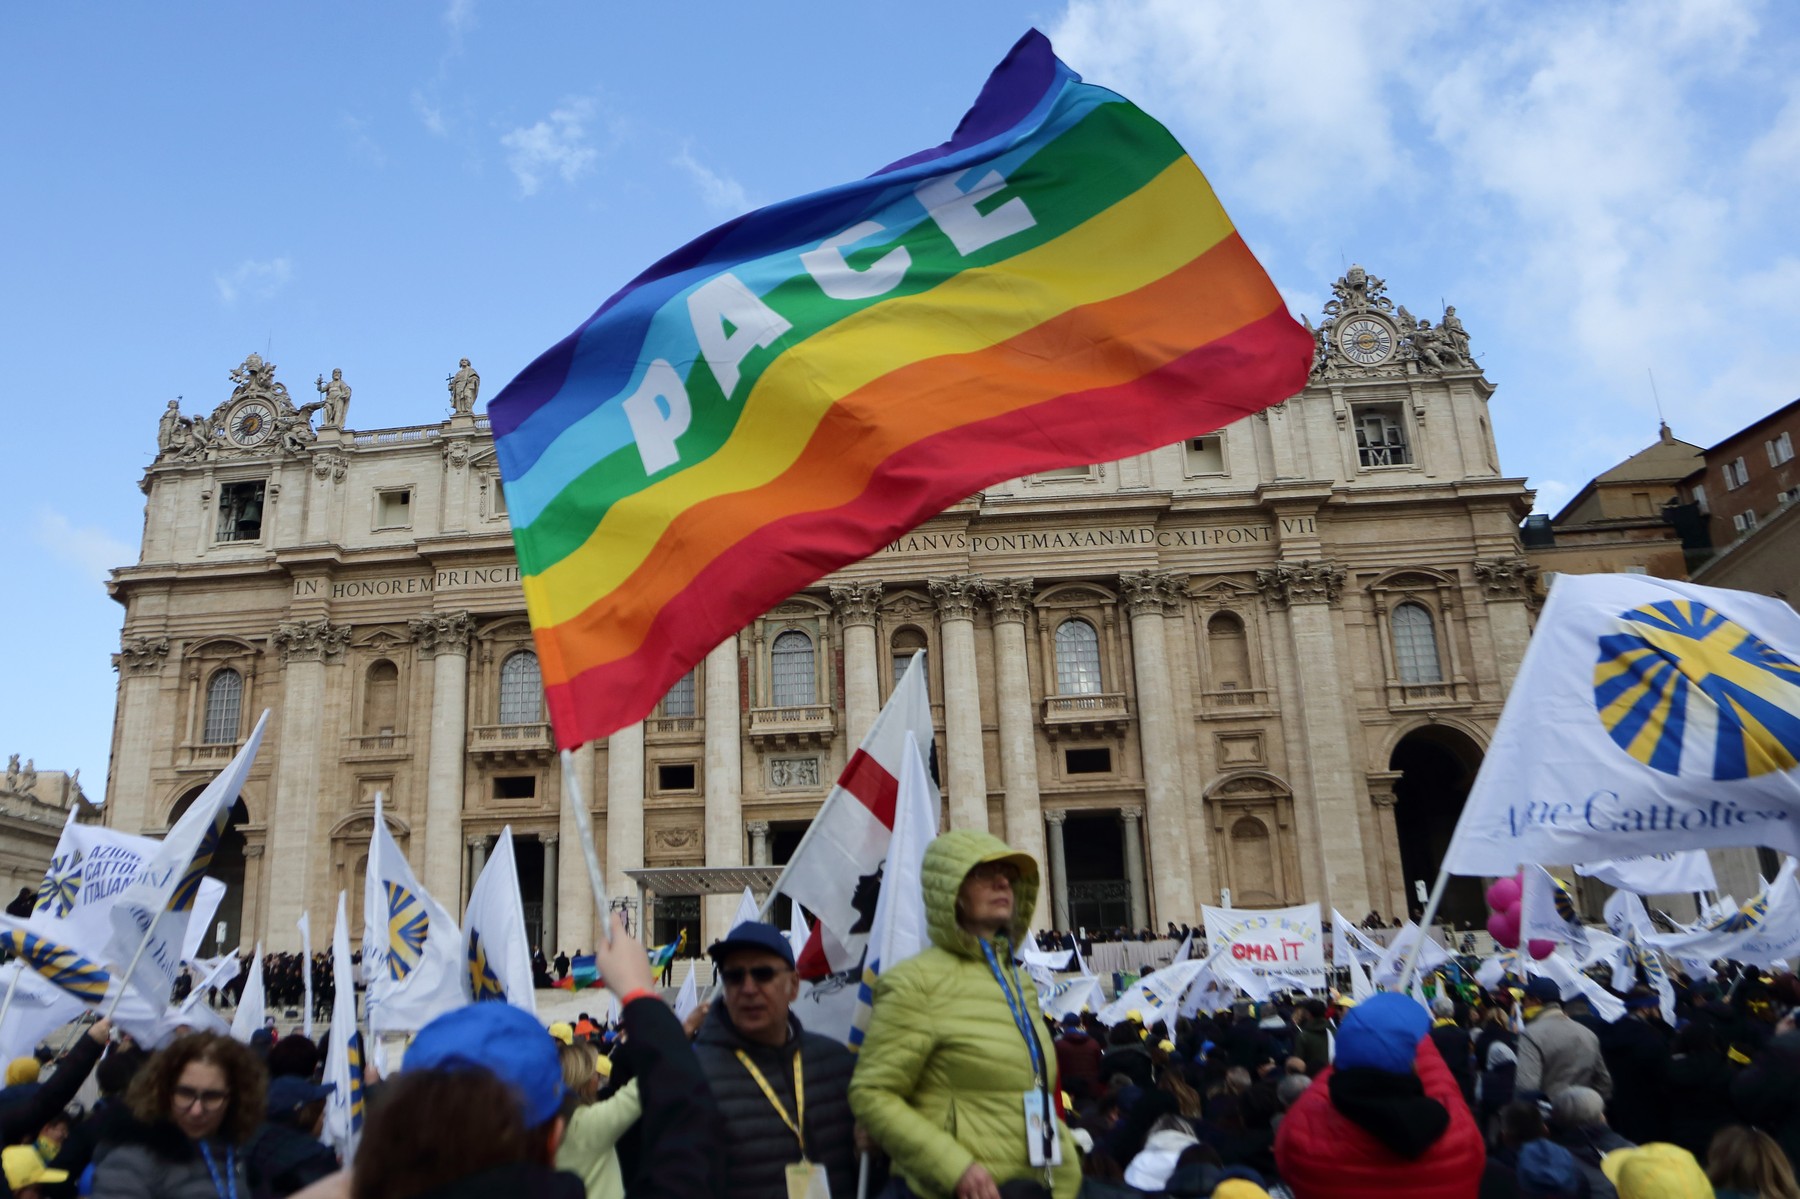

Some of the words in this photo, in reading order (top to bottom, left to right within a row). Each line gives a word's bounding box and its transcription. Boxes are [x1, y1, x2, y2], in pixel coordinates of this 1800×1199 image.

[622, 169, 1037, 476] PACE
[295, 580, 318, 596] IN
[332, 577, 434, 598] HONOREM
[971, 534, 1030, 552] PONT
[1032, 532, 1081, 549] MAX
[1213, 527, 1272, 544] PONT
[1281, 518, 1315, 534] VII
